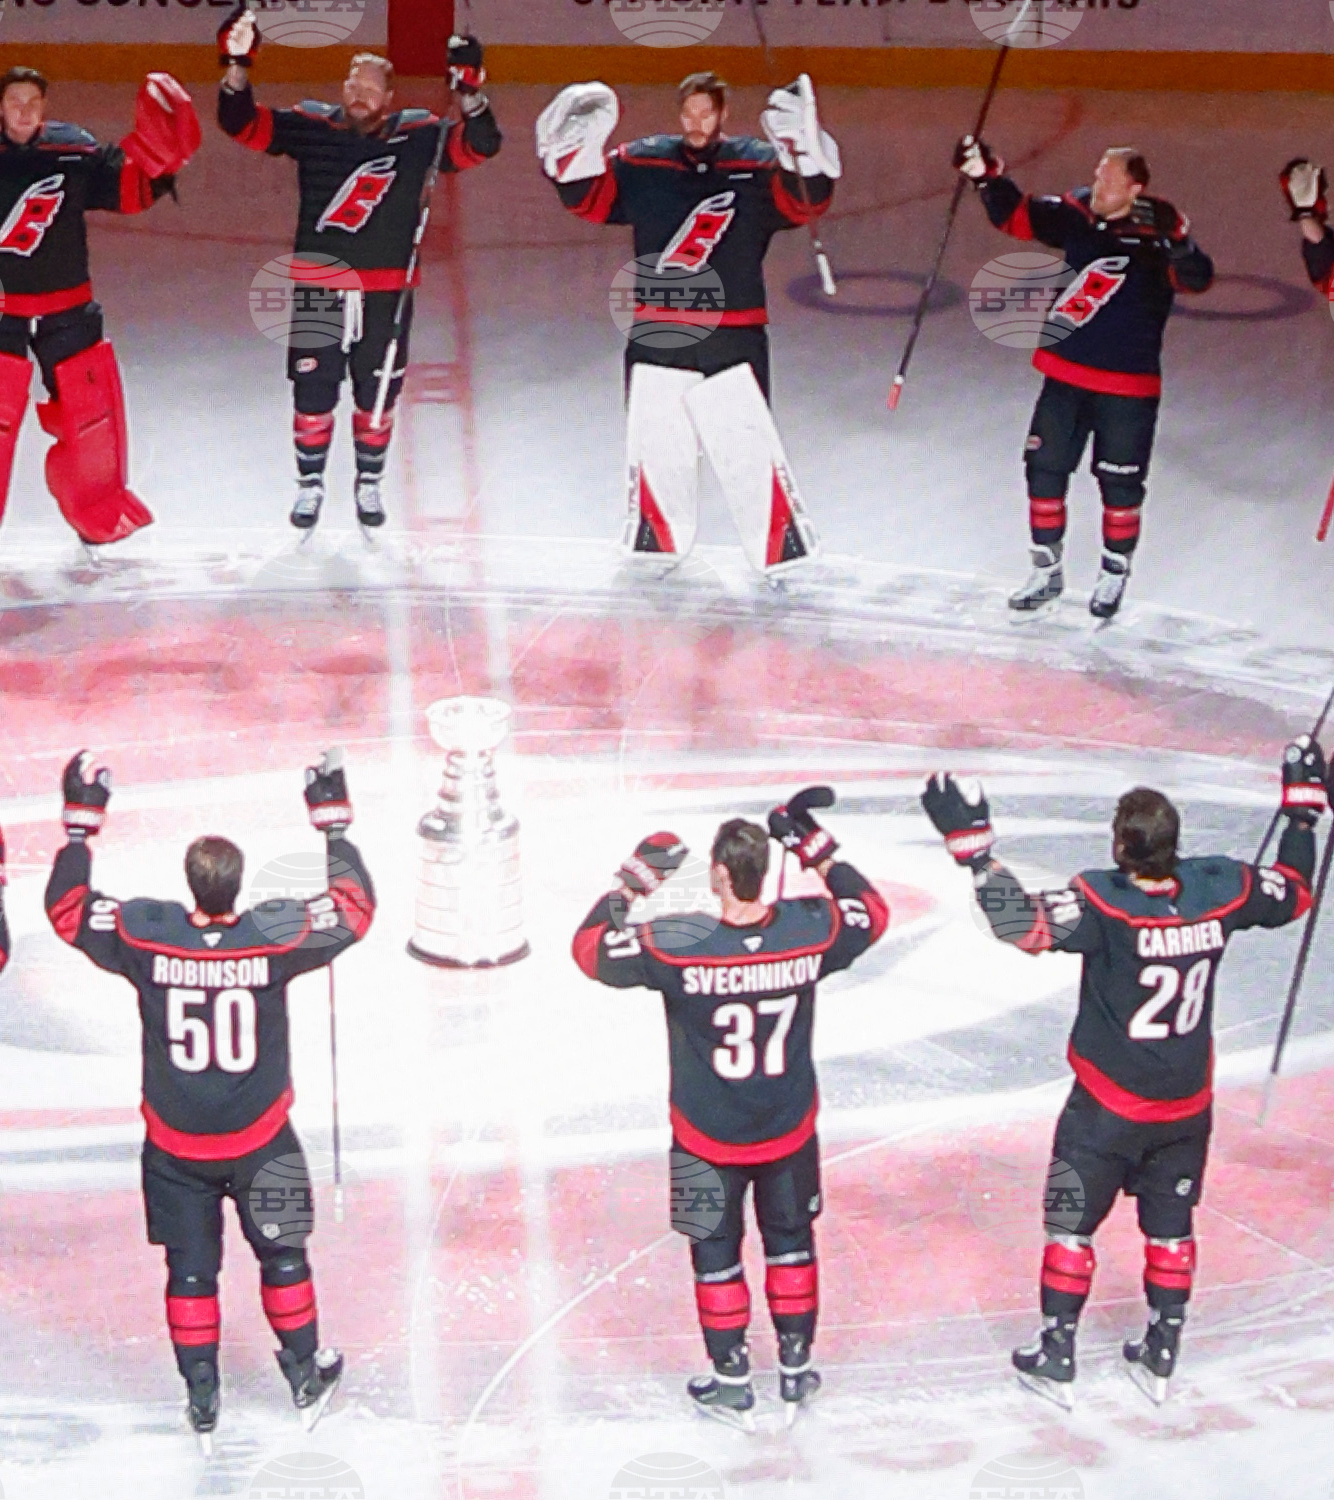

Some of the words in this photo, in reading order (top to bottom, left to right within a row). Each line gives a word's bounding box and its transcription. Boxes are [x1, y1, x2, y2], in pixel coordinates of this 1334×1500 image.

[1137, 920, 1224, 958] CARRIER
[153, 955, 270, 989] ROBINSON
[682, 955, 824, 996] SVECHNIKOV
[1129, 958, 1213, 1041] 28
[167, 988, 259, 1075] 50
[711, 994, 800, 1079] 37
